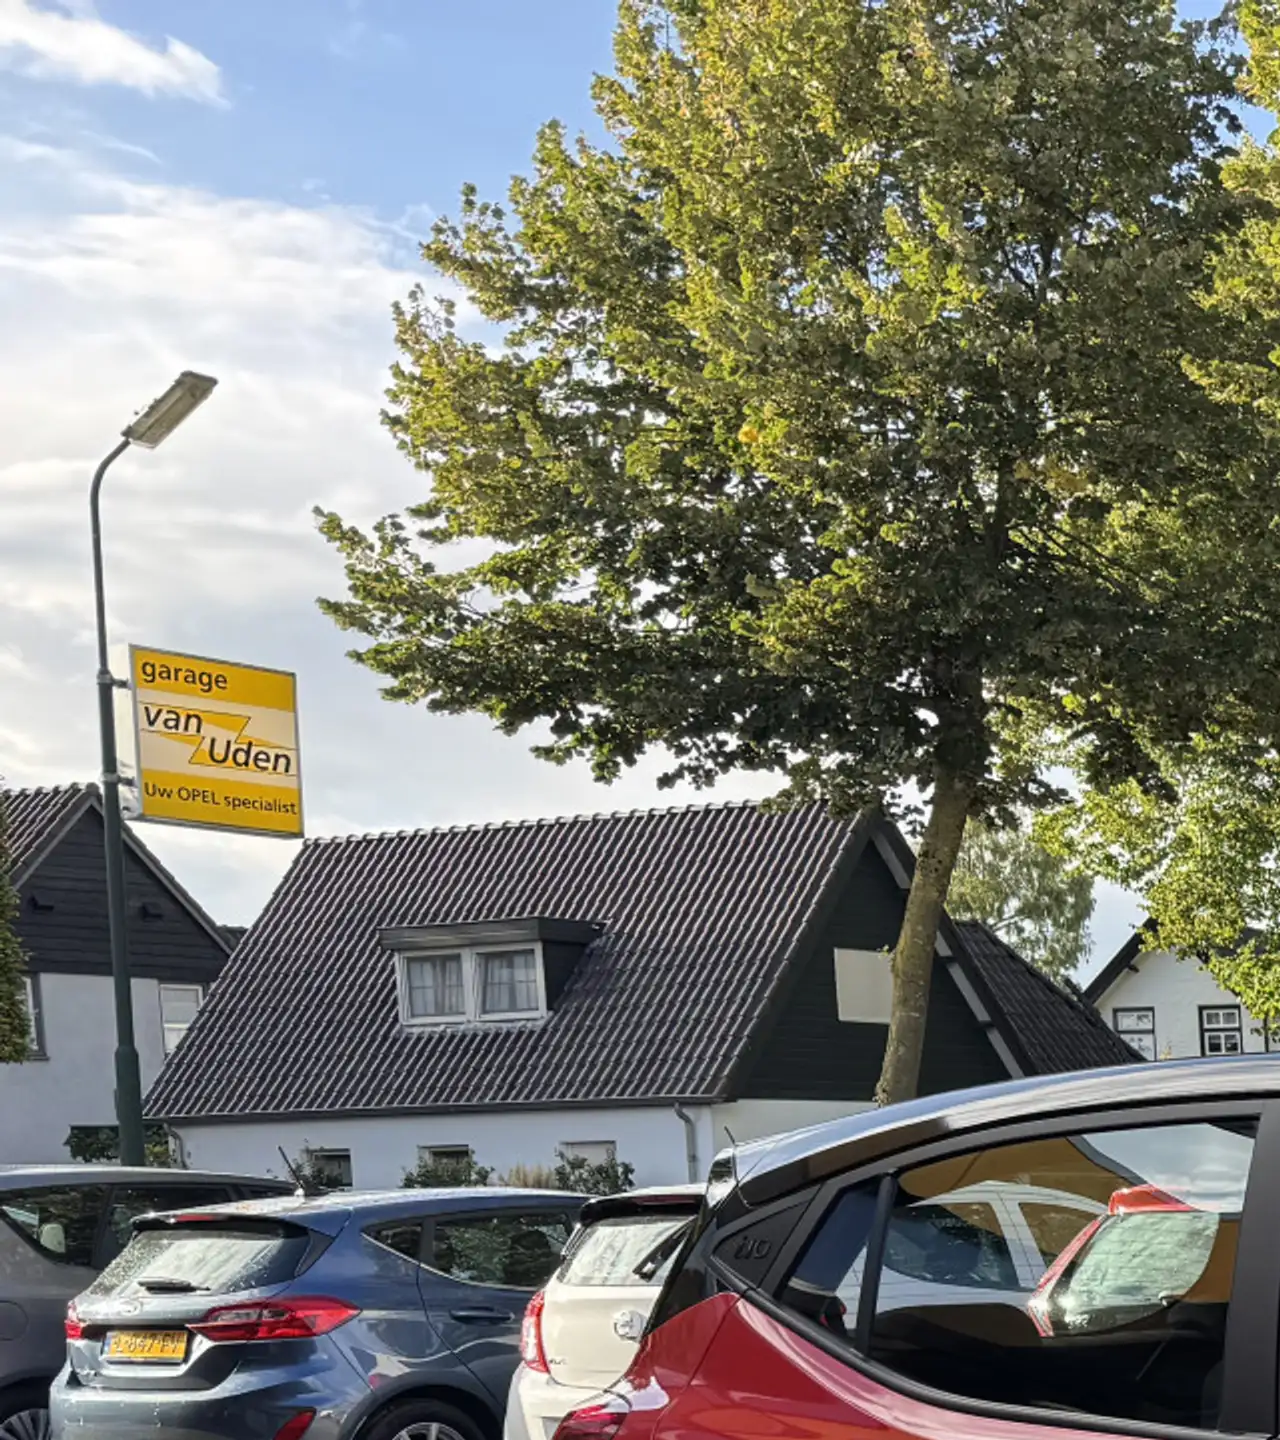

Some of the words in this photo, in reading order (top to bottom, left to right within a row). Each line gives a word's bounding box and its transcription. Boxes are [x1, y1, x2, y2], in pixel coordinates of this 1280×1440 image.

[141, 661, 228, 693] garage
[144, 705, 203, 734] van
[208, 737, 292, 774] Uden
[144, 782, 173, 799] Uw
[177, 786, 220, 805] OPEL
[224, 796, 298, 815] specialist
[734, 1235, 772, 1260] i10
